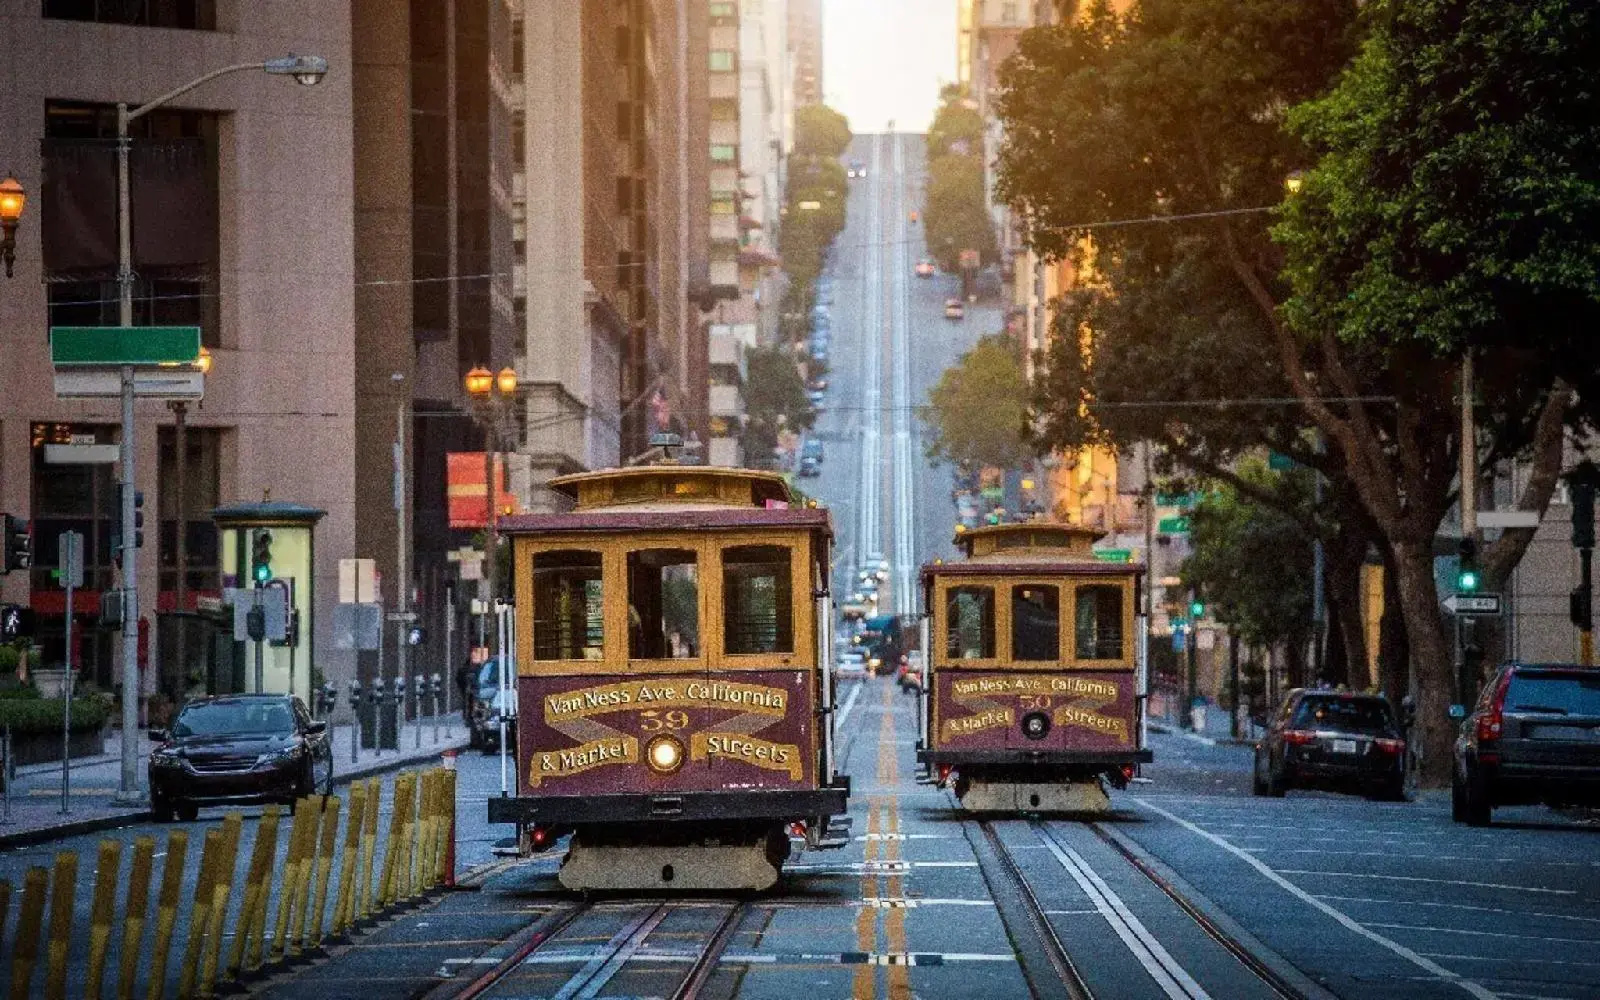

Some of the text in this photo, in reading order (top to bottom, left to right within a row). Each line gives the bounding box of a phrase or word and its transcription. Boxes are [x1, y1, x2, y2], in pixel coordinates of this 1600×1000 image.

[955, 681, 978, 694] Van
[979, 679, 1011, 692] Ness
[1051, 678, 1116, 696] California
[549, 697, 582, 715] Van
[583, 690, 631, 707] Ness
[687, 683, 783, 708] California
[640, 710, 689, 731] 59
[950, 711, 1009, 731] & Market
[1065, 708, 1120, 730] Streets
[542, 742, 629, 771] & Market
[707, 736, 789, 763] Streets
